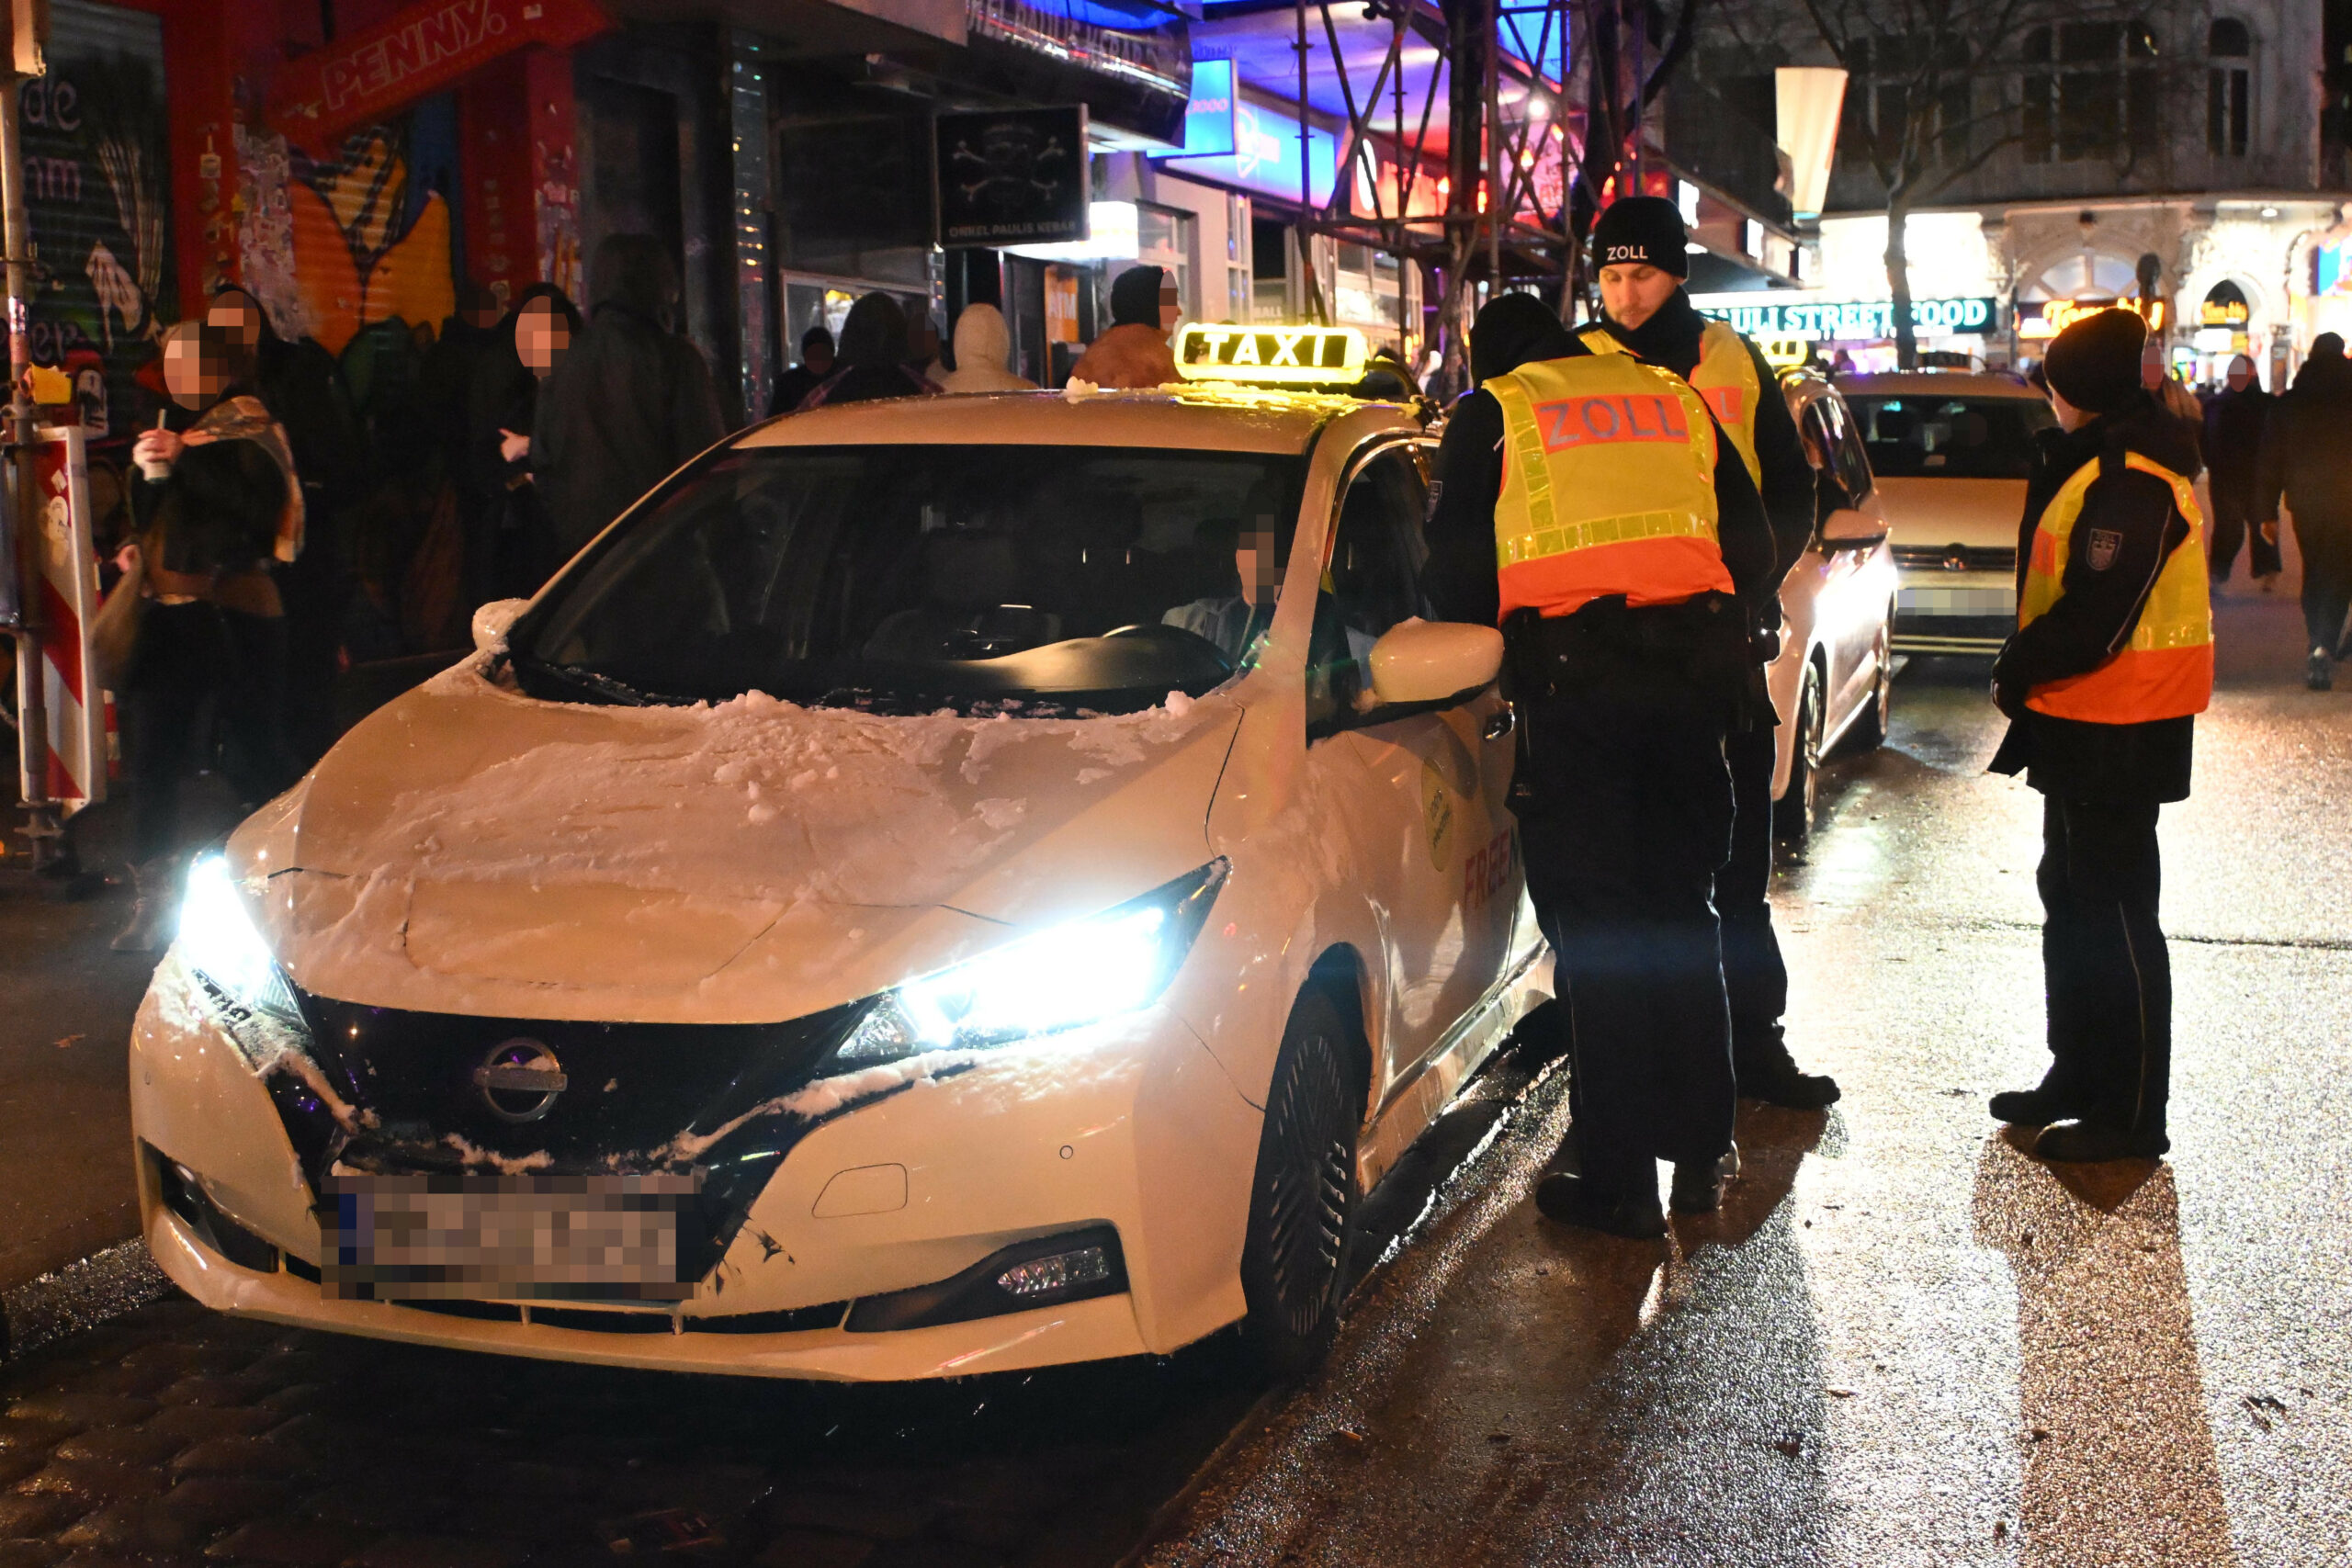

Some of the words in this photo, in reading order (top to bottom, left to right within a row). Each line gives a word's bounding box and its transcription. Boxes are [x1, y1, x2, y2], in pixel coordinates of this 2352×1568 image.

[1607, 245, 1649, 262] ZOLL
[1784, 302, 1894, 332] STREET
[1203, 333, 1327, 367] TAXI
[1538, 398, 1687, 447] ZOLL
